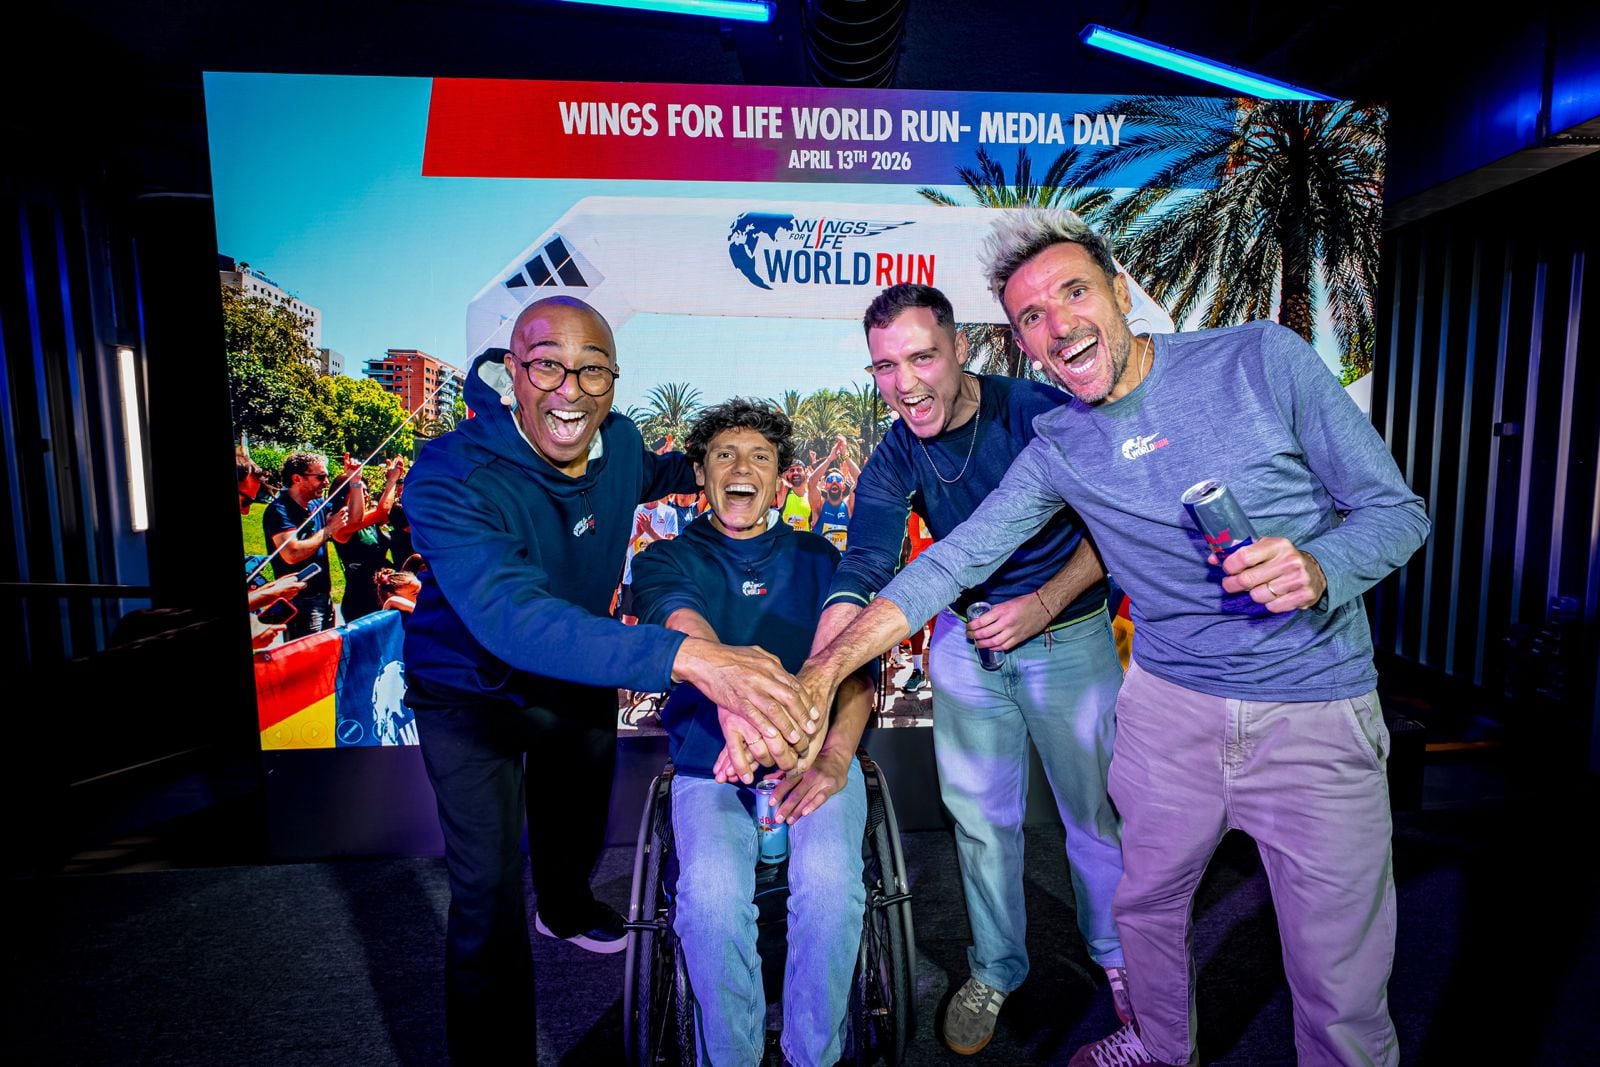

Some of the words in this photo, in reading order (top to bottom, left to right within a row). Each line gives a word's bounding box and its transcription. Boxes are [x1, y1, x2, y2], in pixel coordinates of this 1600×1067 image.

[558, 101, 659, 137] WINGS
[667, 103, 724, 138] FOR
[732, 105, 783, 139] LIFE
[791, 107, 893, 141] WORLD
[901, 109, 971, 143] RUN-
[979, 111, 1066, 145] MEDIA
[1073, 113, 1127, 146] DAY
[788, 149, 834, 169] APRIL
[836, 150, 867, 170] 13TH
[871, 151, 912, 171] 2026
[794, 218, 868, 235] WINGS
[789, 233, 805, 241] FOR
[803, 234, 847, 250] LIFE
[764, 248, 871, 286] WORLD
[875, 252, 936, 288] RUN
